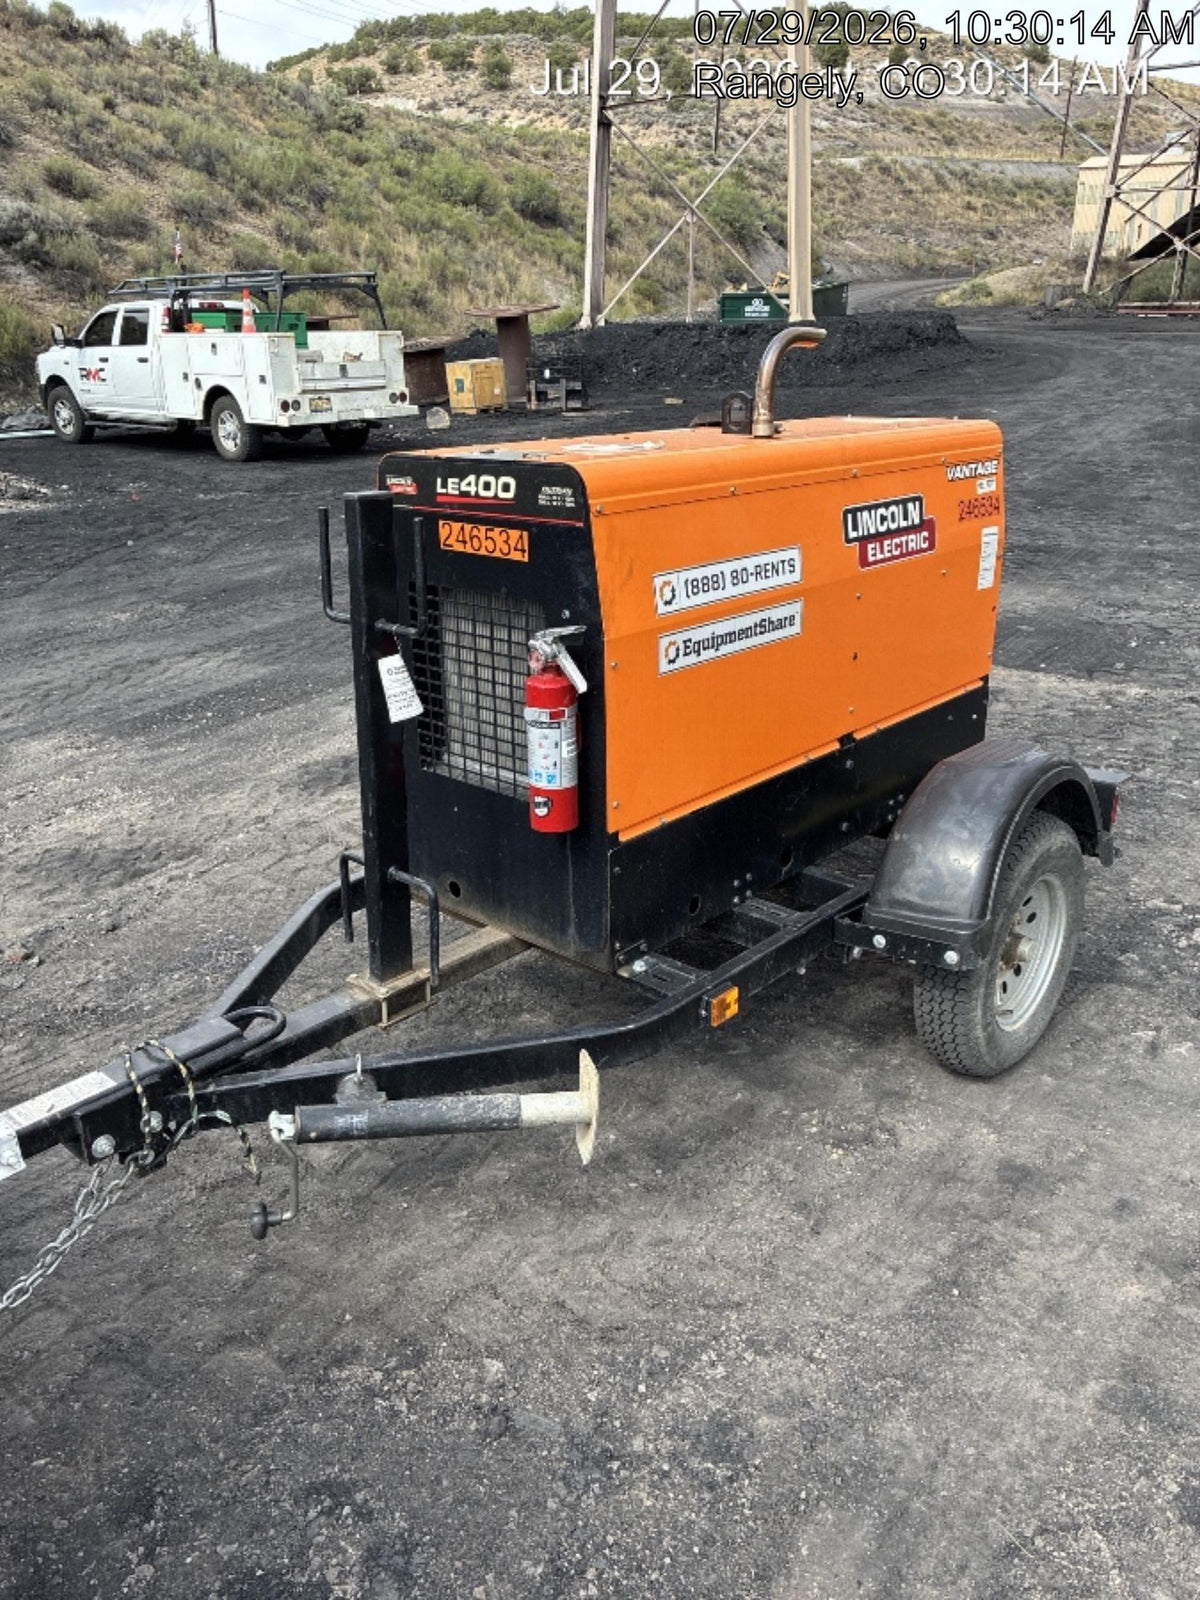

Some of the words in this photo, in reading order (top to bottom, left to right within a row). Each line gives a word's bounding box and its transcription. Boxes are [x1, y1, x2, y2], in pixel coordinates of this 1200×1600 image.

[436, 474, 517, 499] LE400
[946, 459, 999, 481] VANTAGE
[847, 501, 921, 539] LINCOLN
[441, 522, 527, 559] 246534
[867, 531, 930, 562] ELECTRIC
[684, 570, 726, 599] (888)
[730, 557, 796, 587] 80-RENTS
[682, 614, 796, 657] EquipmentShare
